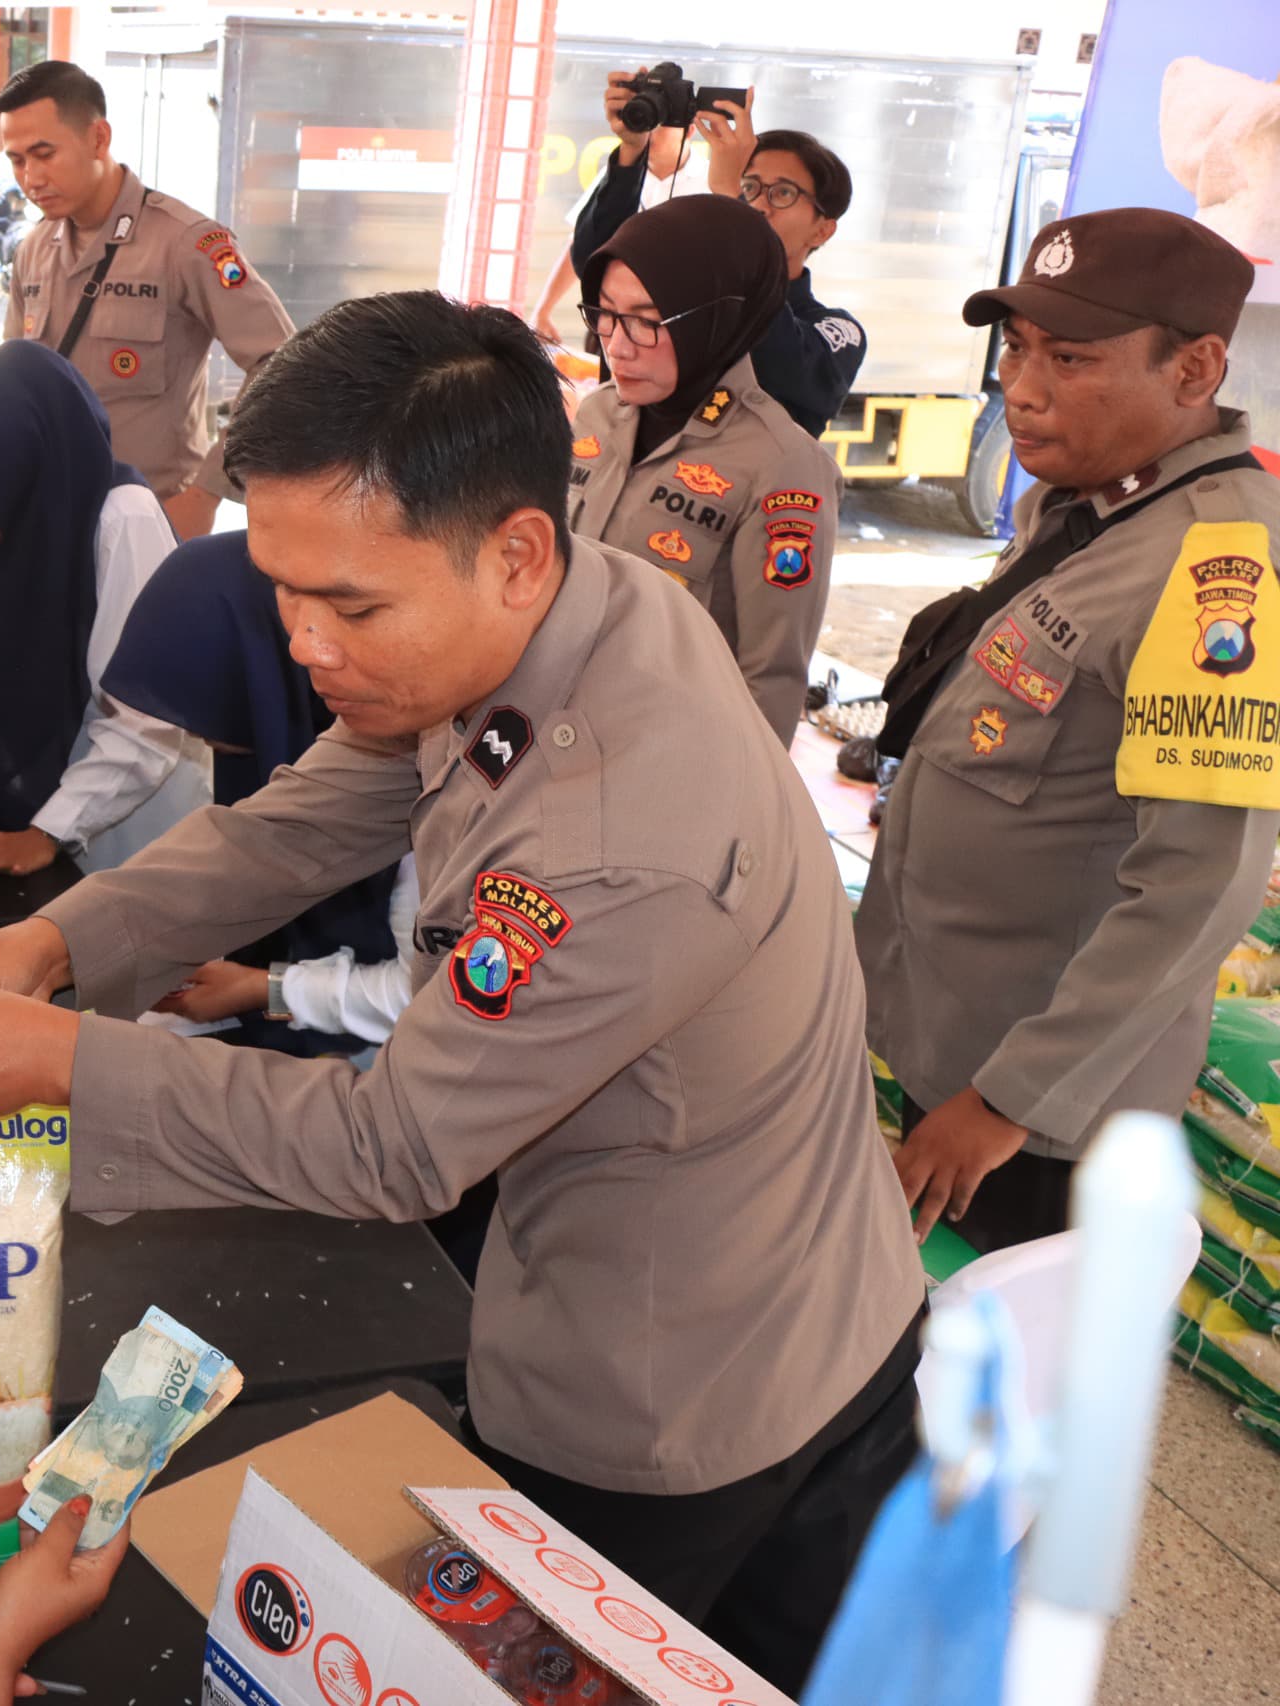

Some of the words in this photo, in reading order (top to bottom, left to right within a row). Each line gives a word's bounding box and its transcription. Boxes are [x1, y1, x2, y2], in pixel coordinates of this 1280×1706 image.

[104, 282, 158, 299] POLRI
[650, 486, 727, 532] POLRI
[767, 493, 814, 509] POLDA
[1197, 560, 1260, 577] POLRES
[1205, 569, 1253, 581] MALANG
[1126, 694, 1280, 746] BHABINKAMTIB
[1156, 748, 1182, 765] DS.
[1191, 750, 1274, 773] SUDIMORO
[483, 877, 562, 926] POLRES
[486, 890, 550, 930] MALANG
[158, 1358, 192, 1412] 2000
[251, 1579, 296, 1645] Cleo
